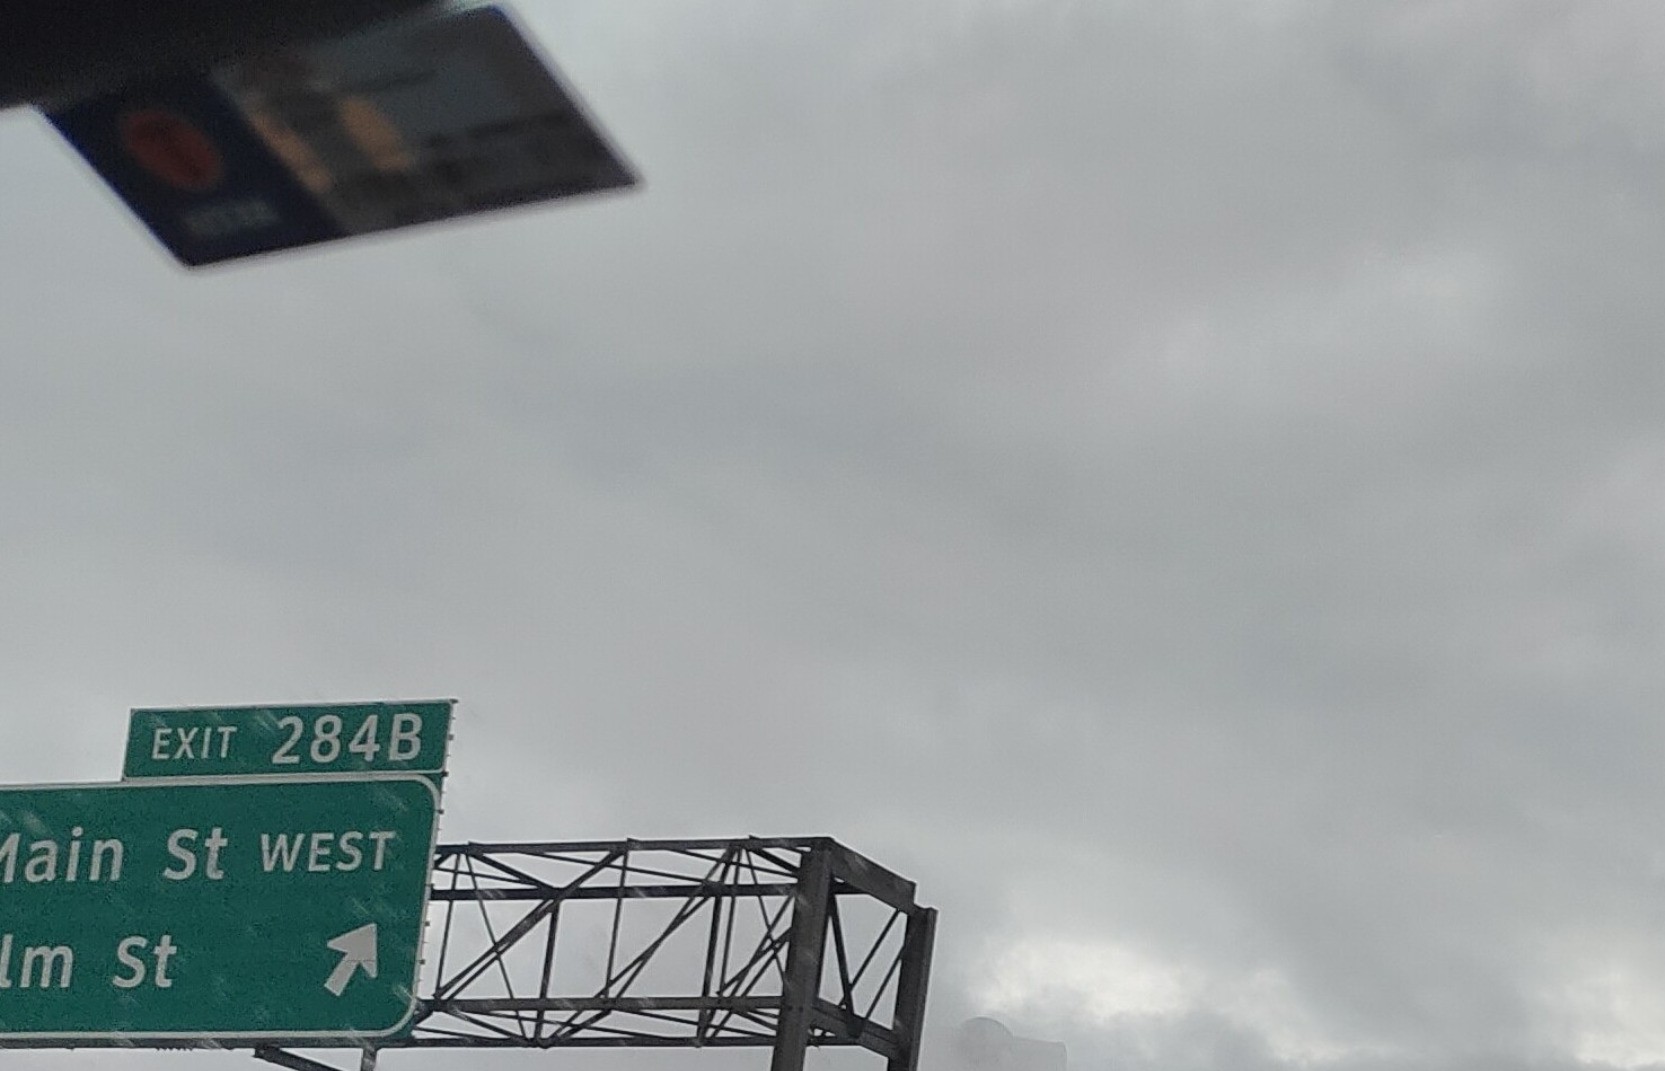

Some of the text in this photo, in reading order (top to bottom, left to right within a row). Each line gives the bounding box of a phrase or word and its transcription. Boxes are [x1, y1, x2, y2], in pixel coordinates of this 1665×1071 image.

[152, 713, 424, 765] EXIT 284B
[163, 826, 229, 881] St
[259, 830, 397, 873] WEST
[0, 933, 178, 989] lm St
